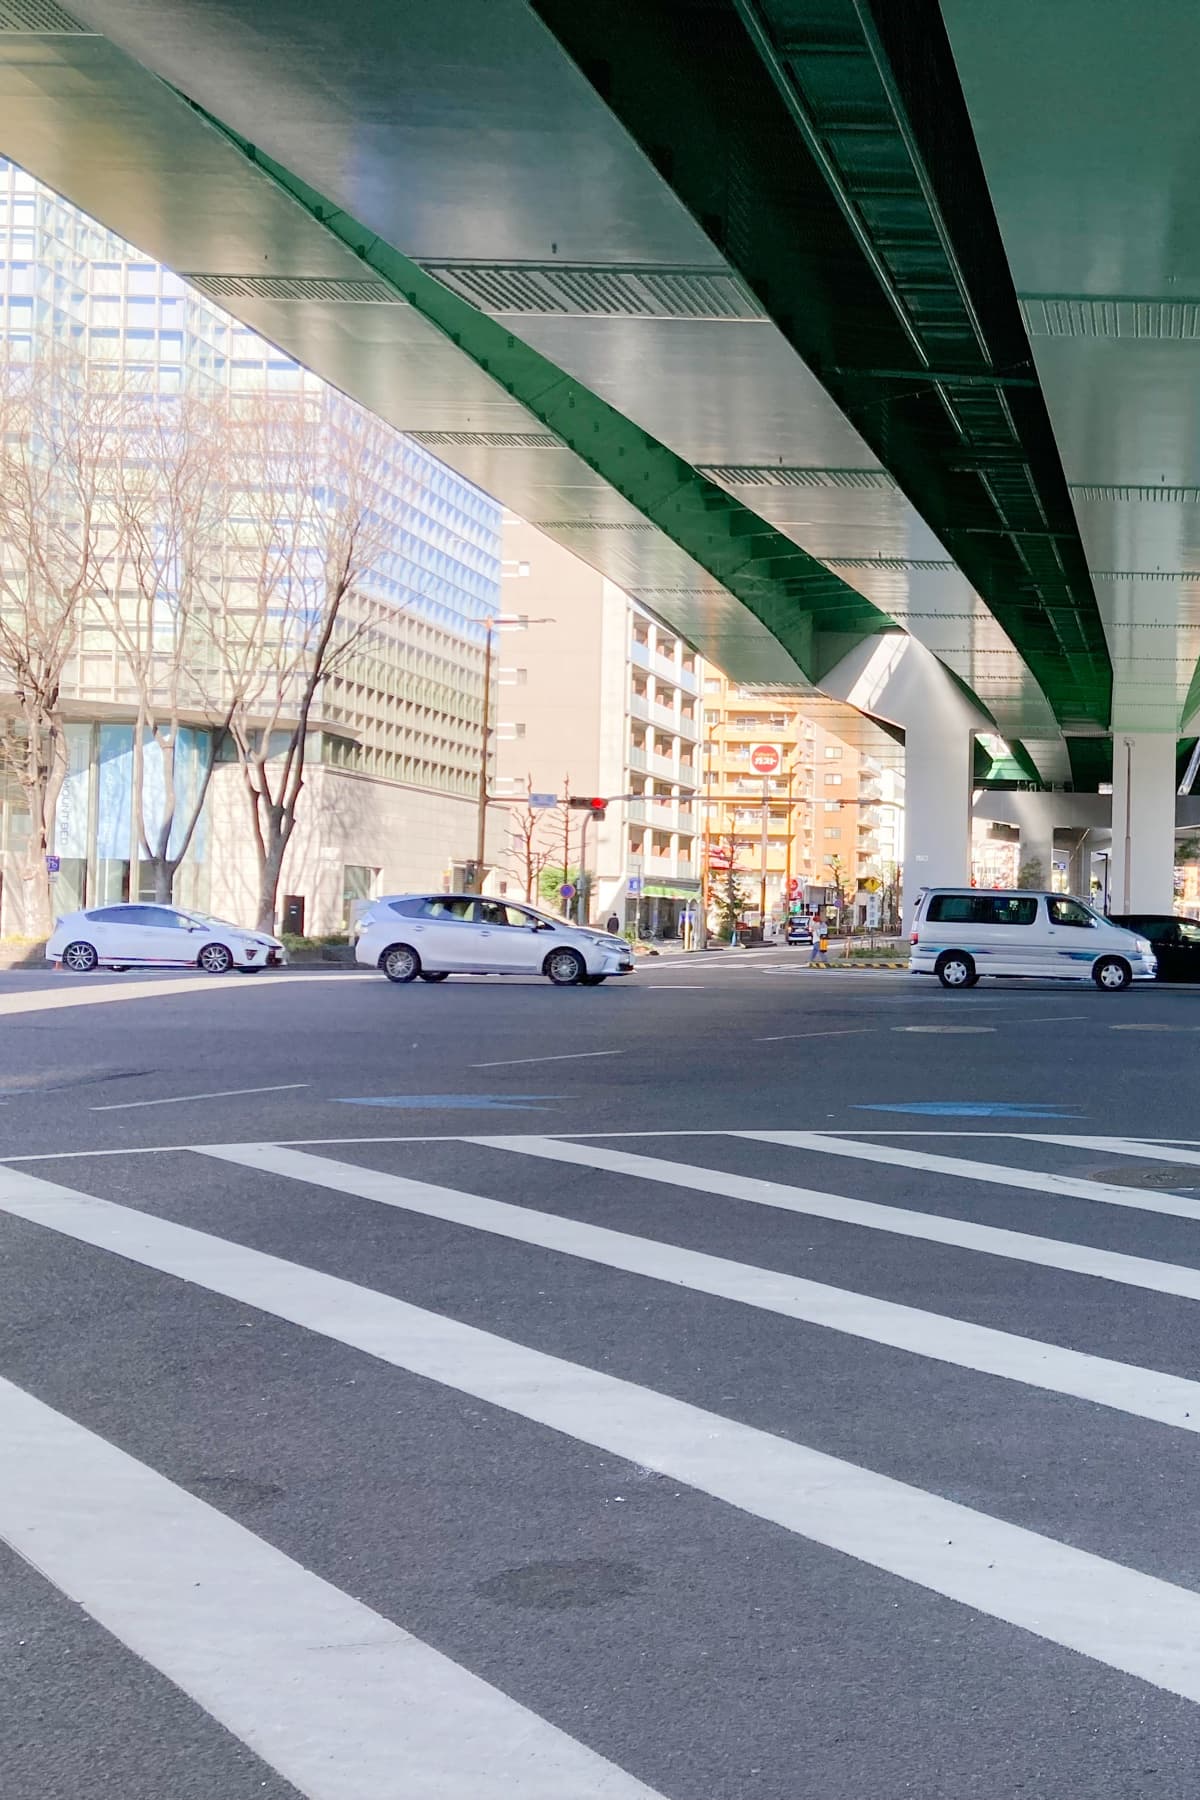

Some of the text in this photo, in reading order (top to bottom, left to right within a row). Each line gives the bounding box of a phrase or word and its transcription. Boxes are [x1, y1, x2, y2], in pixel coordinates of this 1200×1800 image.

[755, 756, 776, 765] ガスト
[60, 823, 69, 846] BED
